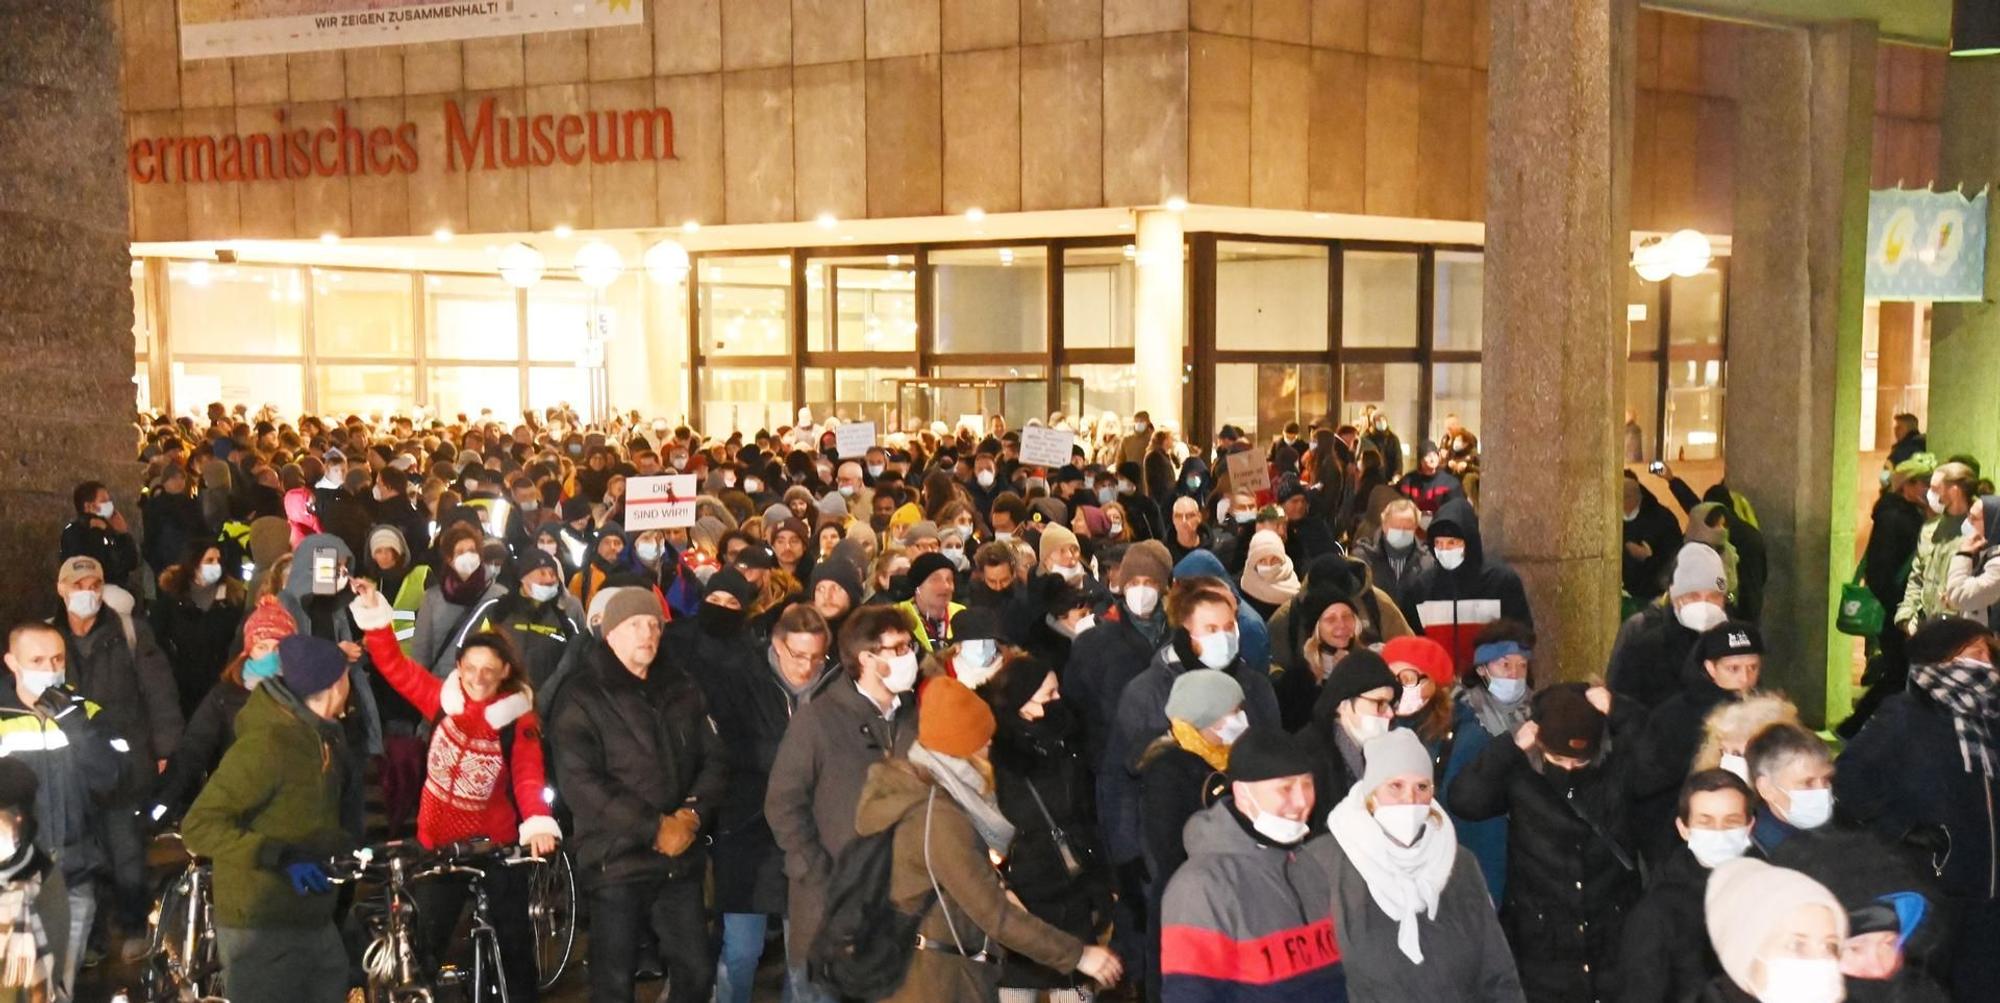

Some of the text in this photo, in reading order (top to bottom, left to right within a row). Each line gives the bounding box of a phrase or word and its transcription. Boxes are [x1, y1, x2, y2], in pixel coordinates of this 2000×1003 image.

[315, 16, 338, 29] WIR
[341, 13, 386, 27] ZEIGEN
[388, 2, 499, 23] ZUSAMMENHALT!
[129, 97, 680, 184] ermanisches Museum
[634, 509, 659, 520] SIND
[1260, 945, 1275, 977] 1
[1284, 935, 1313, 972] FC
